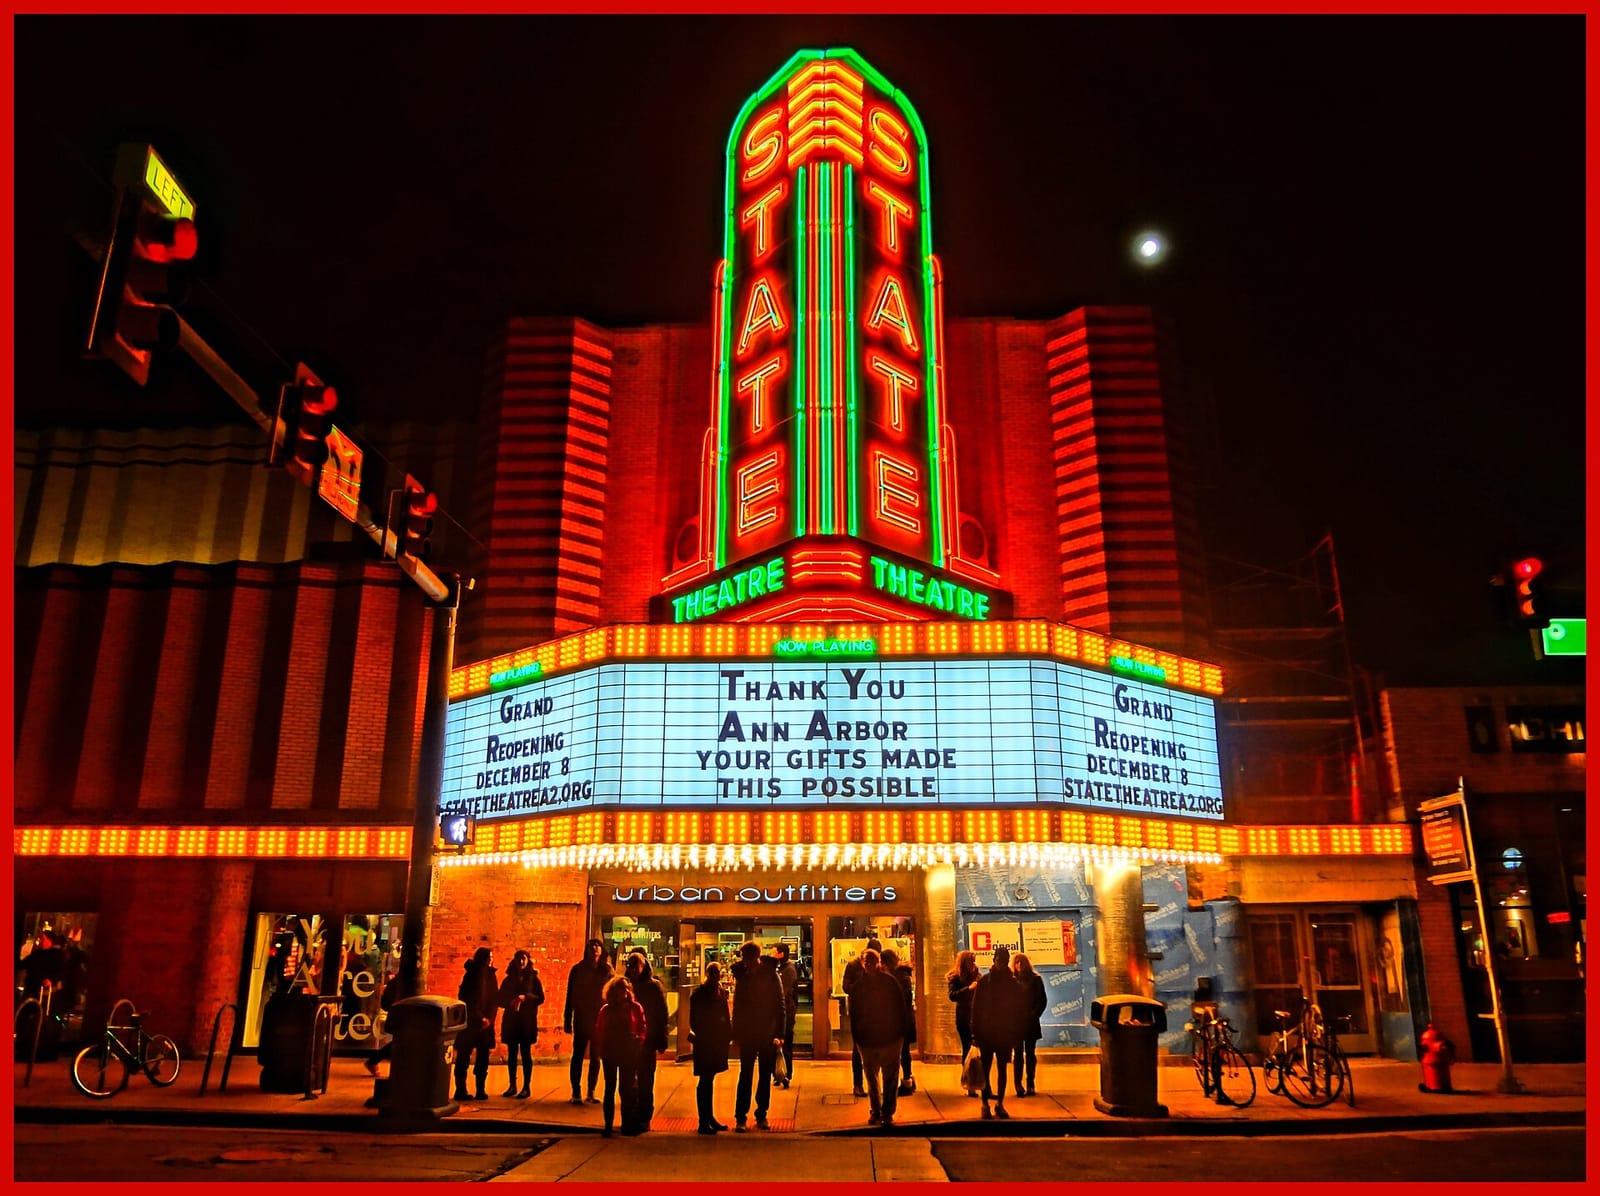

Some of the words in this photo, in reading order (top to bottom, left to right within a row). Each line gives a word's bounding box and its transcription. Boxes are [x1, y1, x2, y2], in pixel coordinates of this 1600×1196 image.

[153, 166, 187, 217] LEFT
[736, 106, 784, 537] STATE
[867, 105, 920, 535] STATE
[670, 556, 785, 624] THEATRE
[870, 556, 990, 621] THEATRE
[777, 640, 807, 652] NOW
[812, 640, 873, 652] PLAYING
[720, 669, 827, 702] THANK
[840, 667, 906, 701] YOU
[1114, 683, 1173, 720] GRAND
[500, 695, 553, 723] GRAND
[718, 710, 790, 743] ANN
[805, 708, 909, 742] ARBOR
[486, 731, 565, 764] REOPENING
[1094, 717, 1187, 761] REOPENING
[476, 760, 551, 791] DECEMBER
[560, 757, 570, 775] 8
[696, 749, 771, 771] YOUR
[786, 748, 867, 770] GIFTS
[881, 747, 957, 770] MADE
[1087, 752, 1171, 784] DECEMBER
[1180, 767, 1189, 786] 8
[718, 777, 782, 799] THIS
[802, 776, 937, 799] POSSIBLE
[614, 884, 724, 901] urban
[738, 883, 897, 901] outfitters
